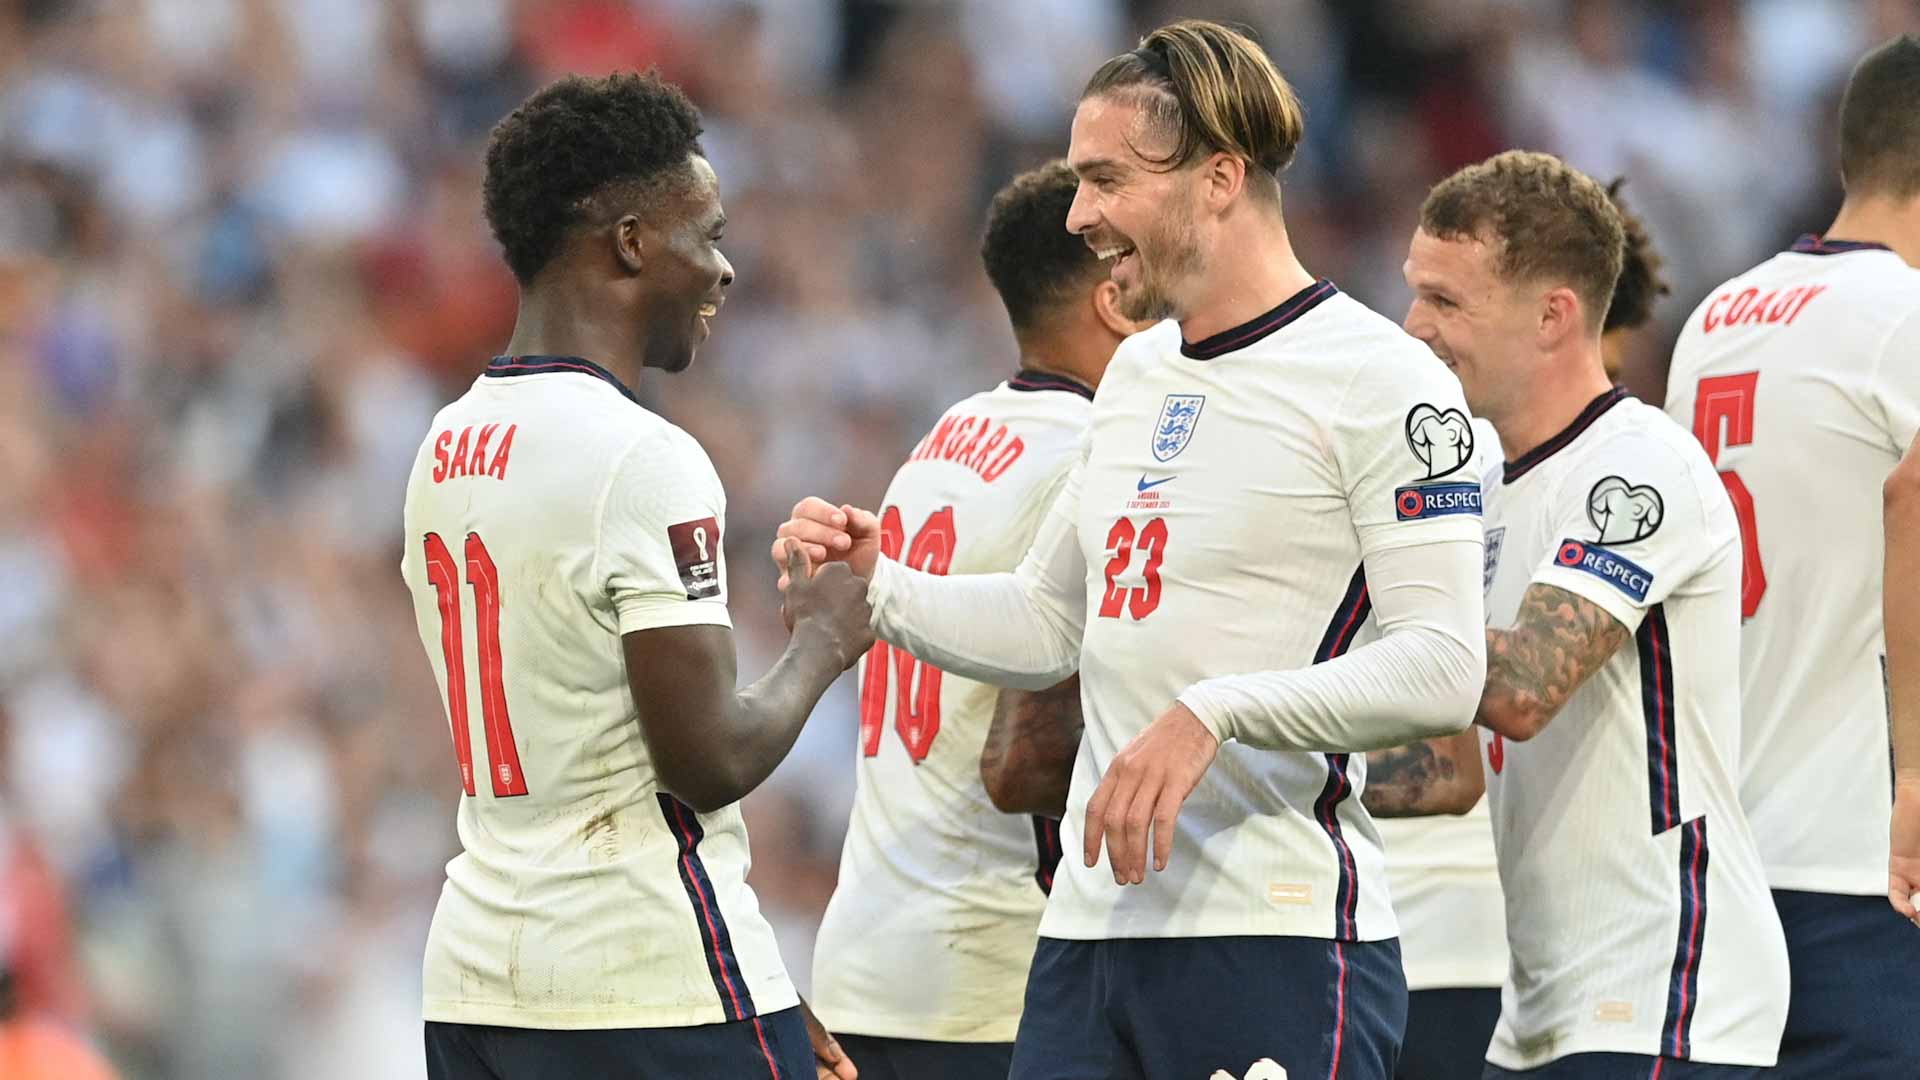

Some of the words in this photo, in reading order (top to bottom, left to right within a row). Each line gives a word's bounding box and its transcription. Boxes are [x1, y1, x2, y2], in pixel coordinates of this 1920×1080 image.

[1704, 285, 1826, 334] COADY
[432, 423, 517, 483] SAKA
[1693, 370, 1767, 617] 5
[1425, 491, 1480, 509] RESPECT
[1098, 516, 1168, 621] 23
[1583, 552, 1649, 593] RESPECT
[424, 531, 529, 797] 11
[861, 505, 956, 765] 10
